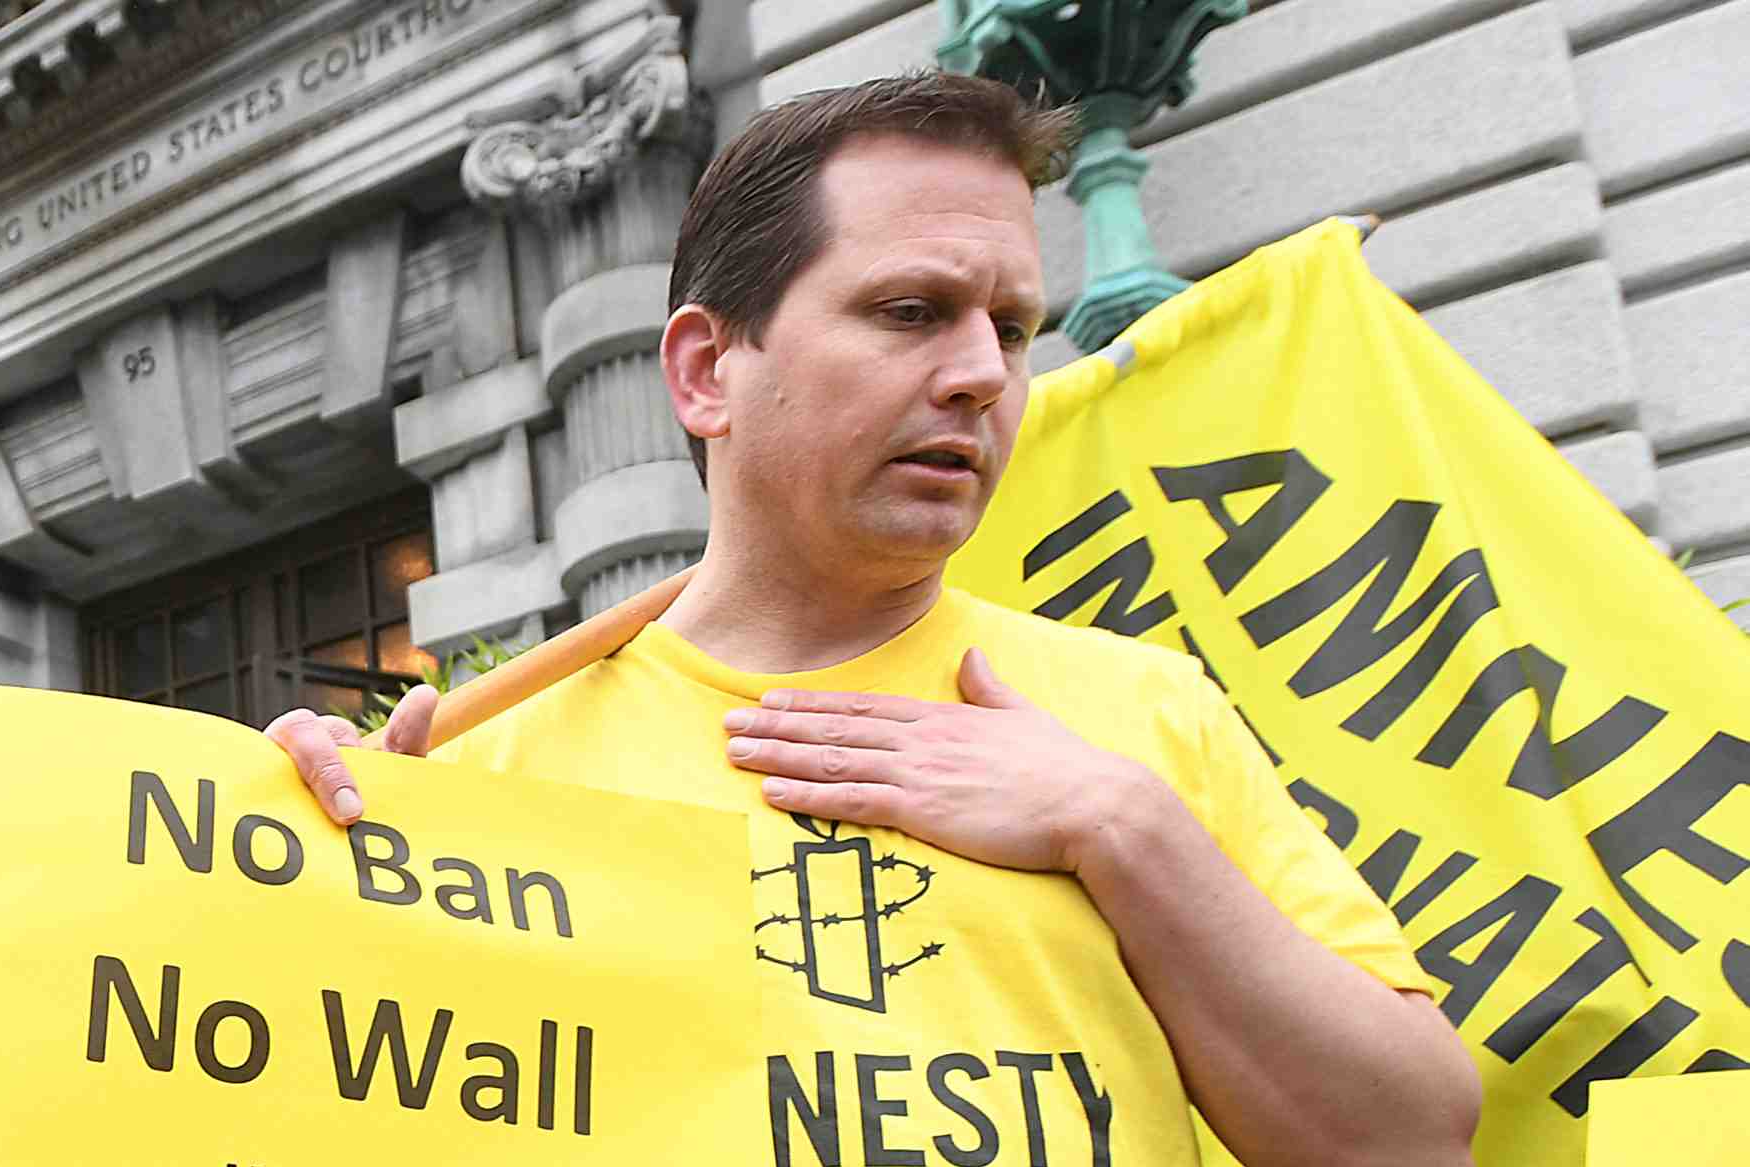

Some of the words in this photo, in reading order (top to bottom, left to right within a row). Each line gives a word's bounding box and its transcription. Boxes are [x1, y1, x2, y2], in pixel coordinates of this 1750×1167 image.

[38, 151, 151, 230] UNITED
[168, 77, 286, 163] STATES
[123, 346, 155, 383] 95
[127, 770, 305, 887] No
[348, 819, 574, 938] Ban
[86, 954, 271, 1084] No
[321, 989, 593, 1136] Wall
